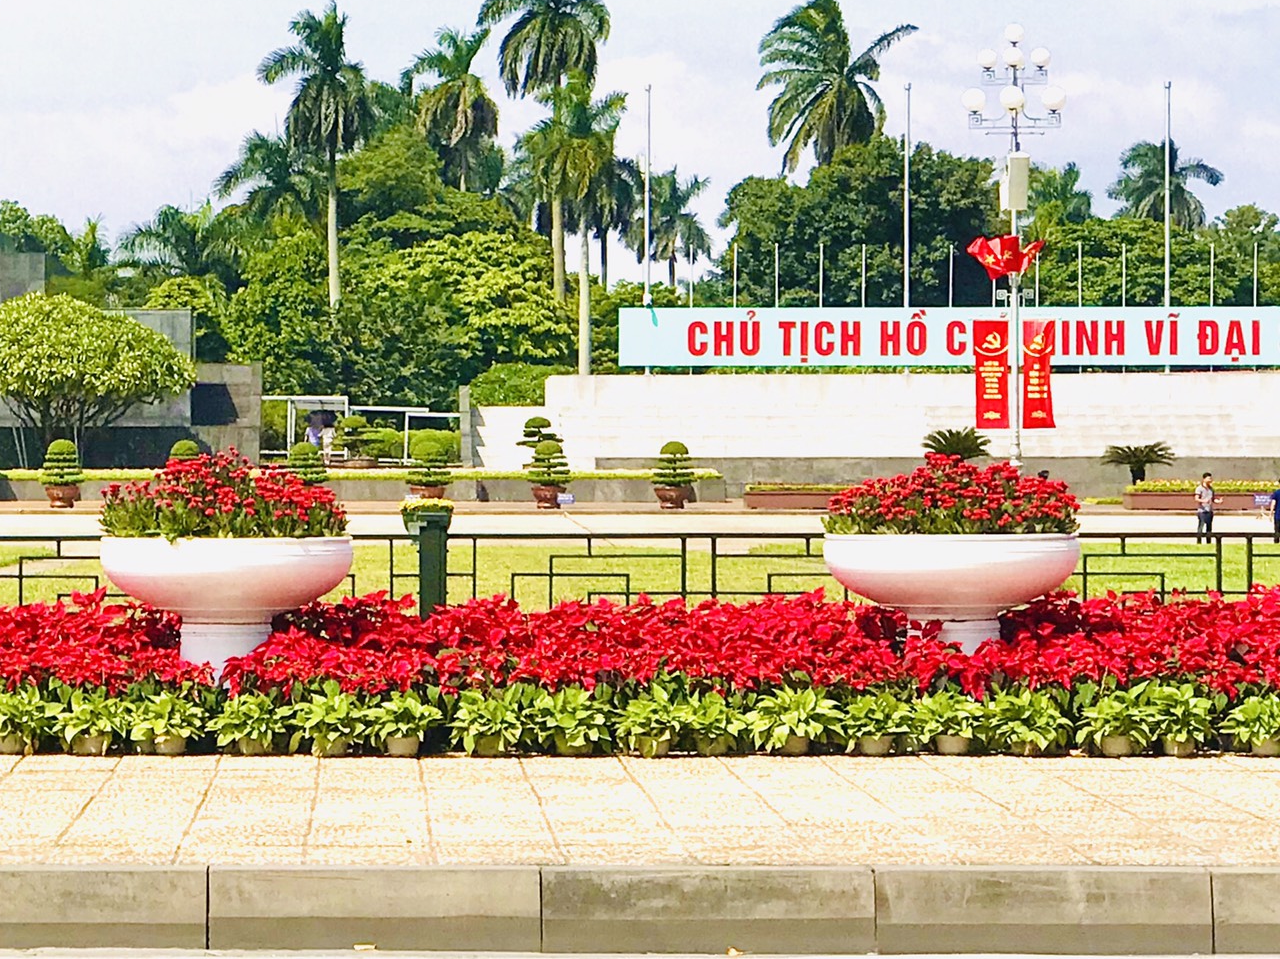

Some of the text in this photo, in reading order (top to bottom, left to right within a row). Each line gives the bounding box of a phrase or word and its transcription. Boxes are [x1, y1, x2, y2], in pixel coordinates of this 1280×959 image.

[688, 311, 760, 356] CHỦ
[779, 321, 860, 362] TỊCH
[880, 310, 926, 356] HỒ
[1028, 321, 1124, 355] INH
[1144, 312, 1180, 356] VĨ
[1197, 321, 1260, 362] ĐẠI
